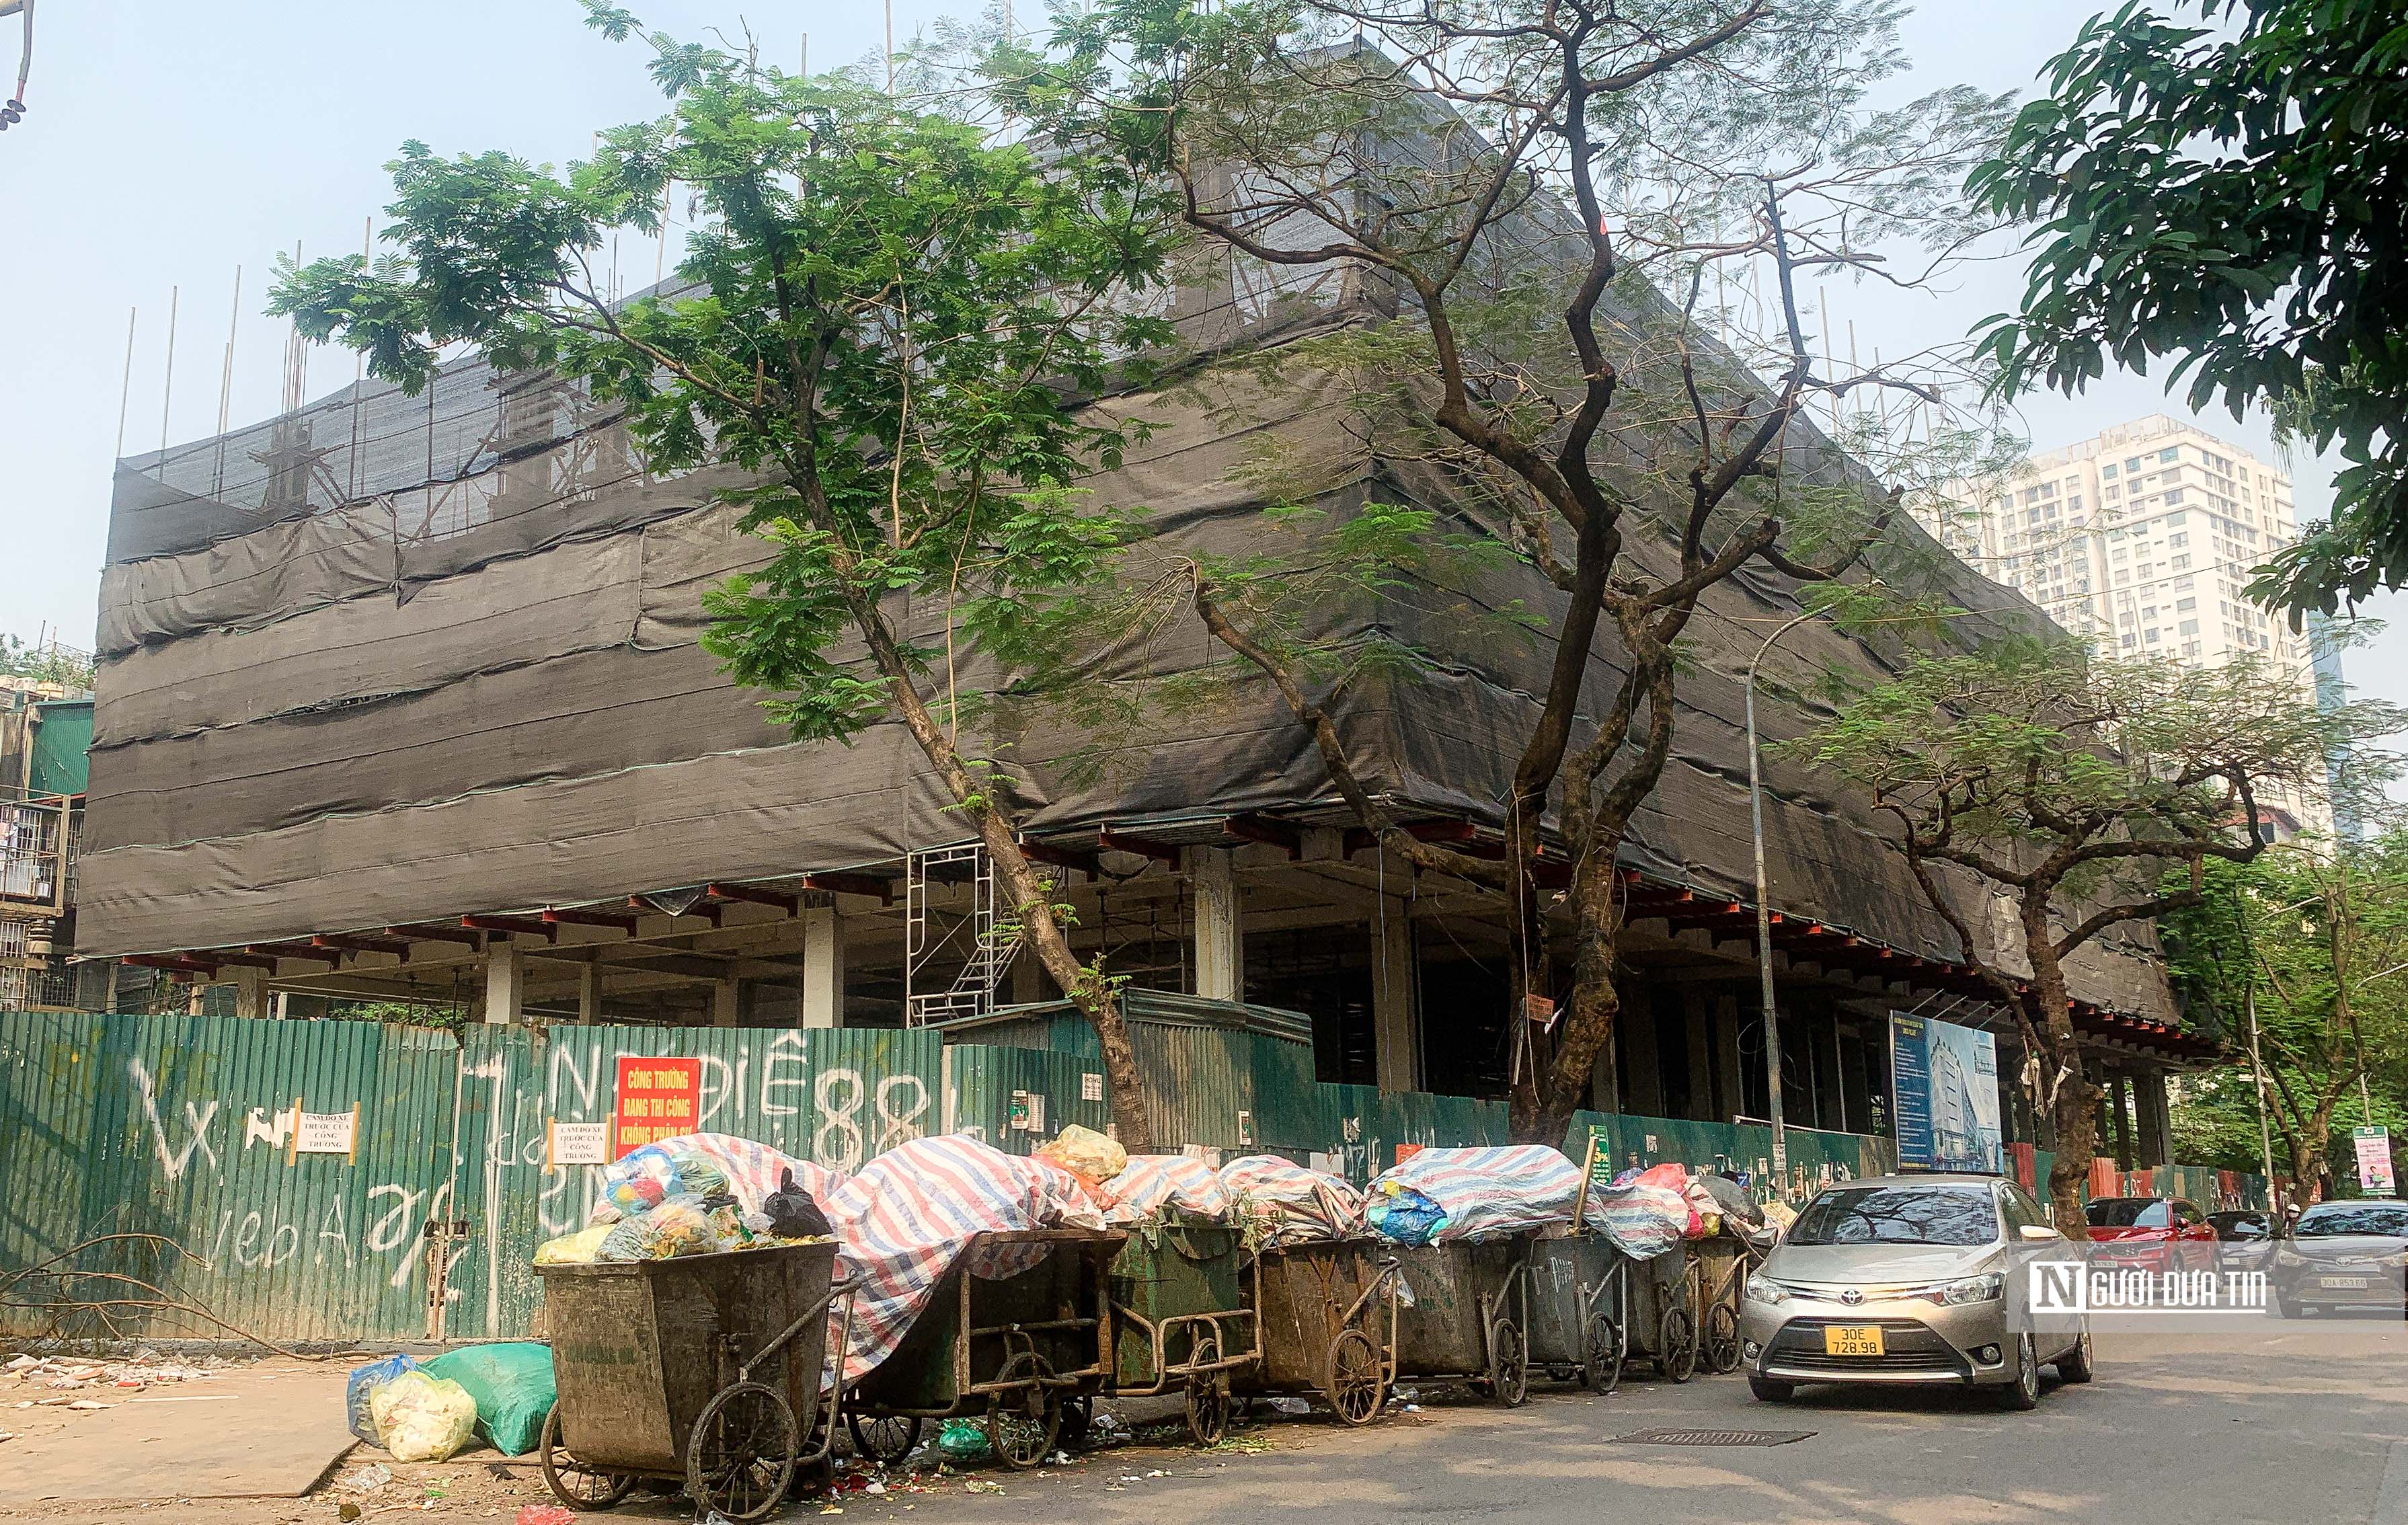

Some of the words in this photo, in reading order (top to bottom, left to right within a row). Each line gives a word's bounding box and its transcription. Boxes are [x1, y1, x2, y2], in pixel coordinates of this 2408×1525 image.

[627, 1066, 652, 1089] CÔNG
[654, 1066, 689, 1089] TRƯỜNG
[623, 1097, 648, 1117] ĐANG
[650, 1098, 664, 1117] THI
[666, 1095, 691, 1117] CÔNG
[620, 1122, 651, 1145] KHÔNG
[1842, 1329, 1866, 1340] 30E
[1832, 1341, 1877, 1354] 728.98
